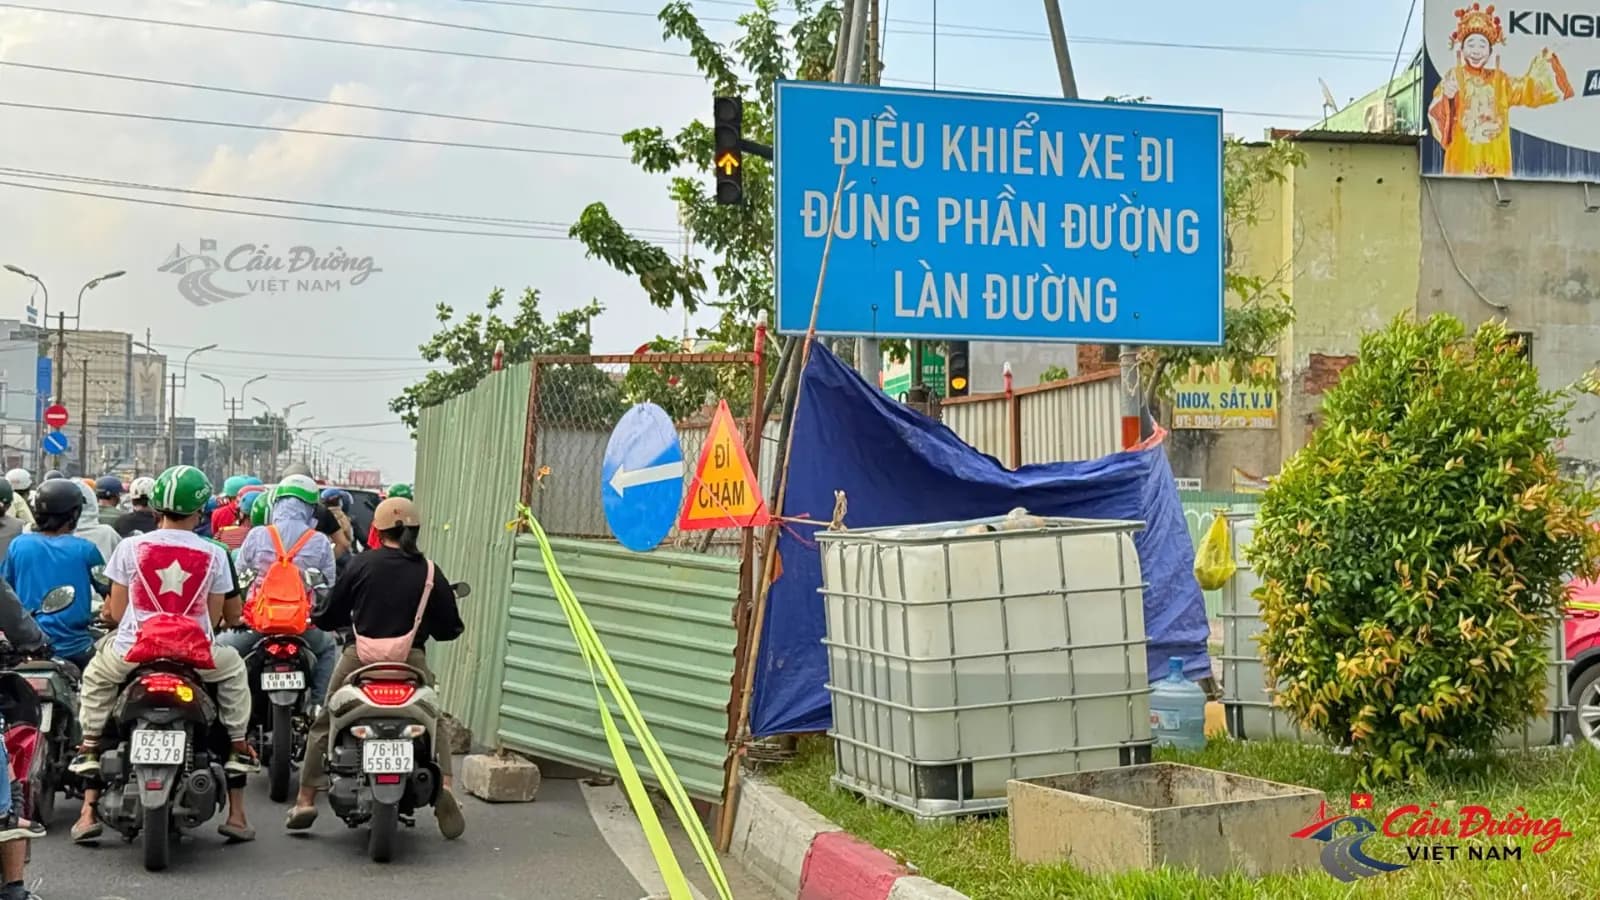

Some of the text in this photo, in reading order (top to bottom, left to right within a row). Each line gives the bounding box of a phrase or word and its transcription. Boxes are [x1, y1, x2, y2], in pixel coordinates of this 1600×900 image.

[1508, 10, 1600, 38] KING
[829, 104, 1175, 184] ĐIỀU KHIỂN XE ĐI
[799, 180, 1201, 255] ĐÚNG PHẦN ĐƯỜNG
[893, 258, 1118, 324] LÀN ĐƯỜNG
[698, 478, 745, 511] CHẬM
[141, 733, 176, 747] 62-G1
[372, 743, 405, 757] 76-H1
[134, 747, 181, 762] 433.78
[367, 757, 411, 771] 556.92
